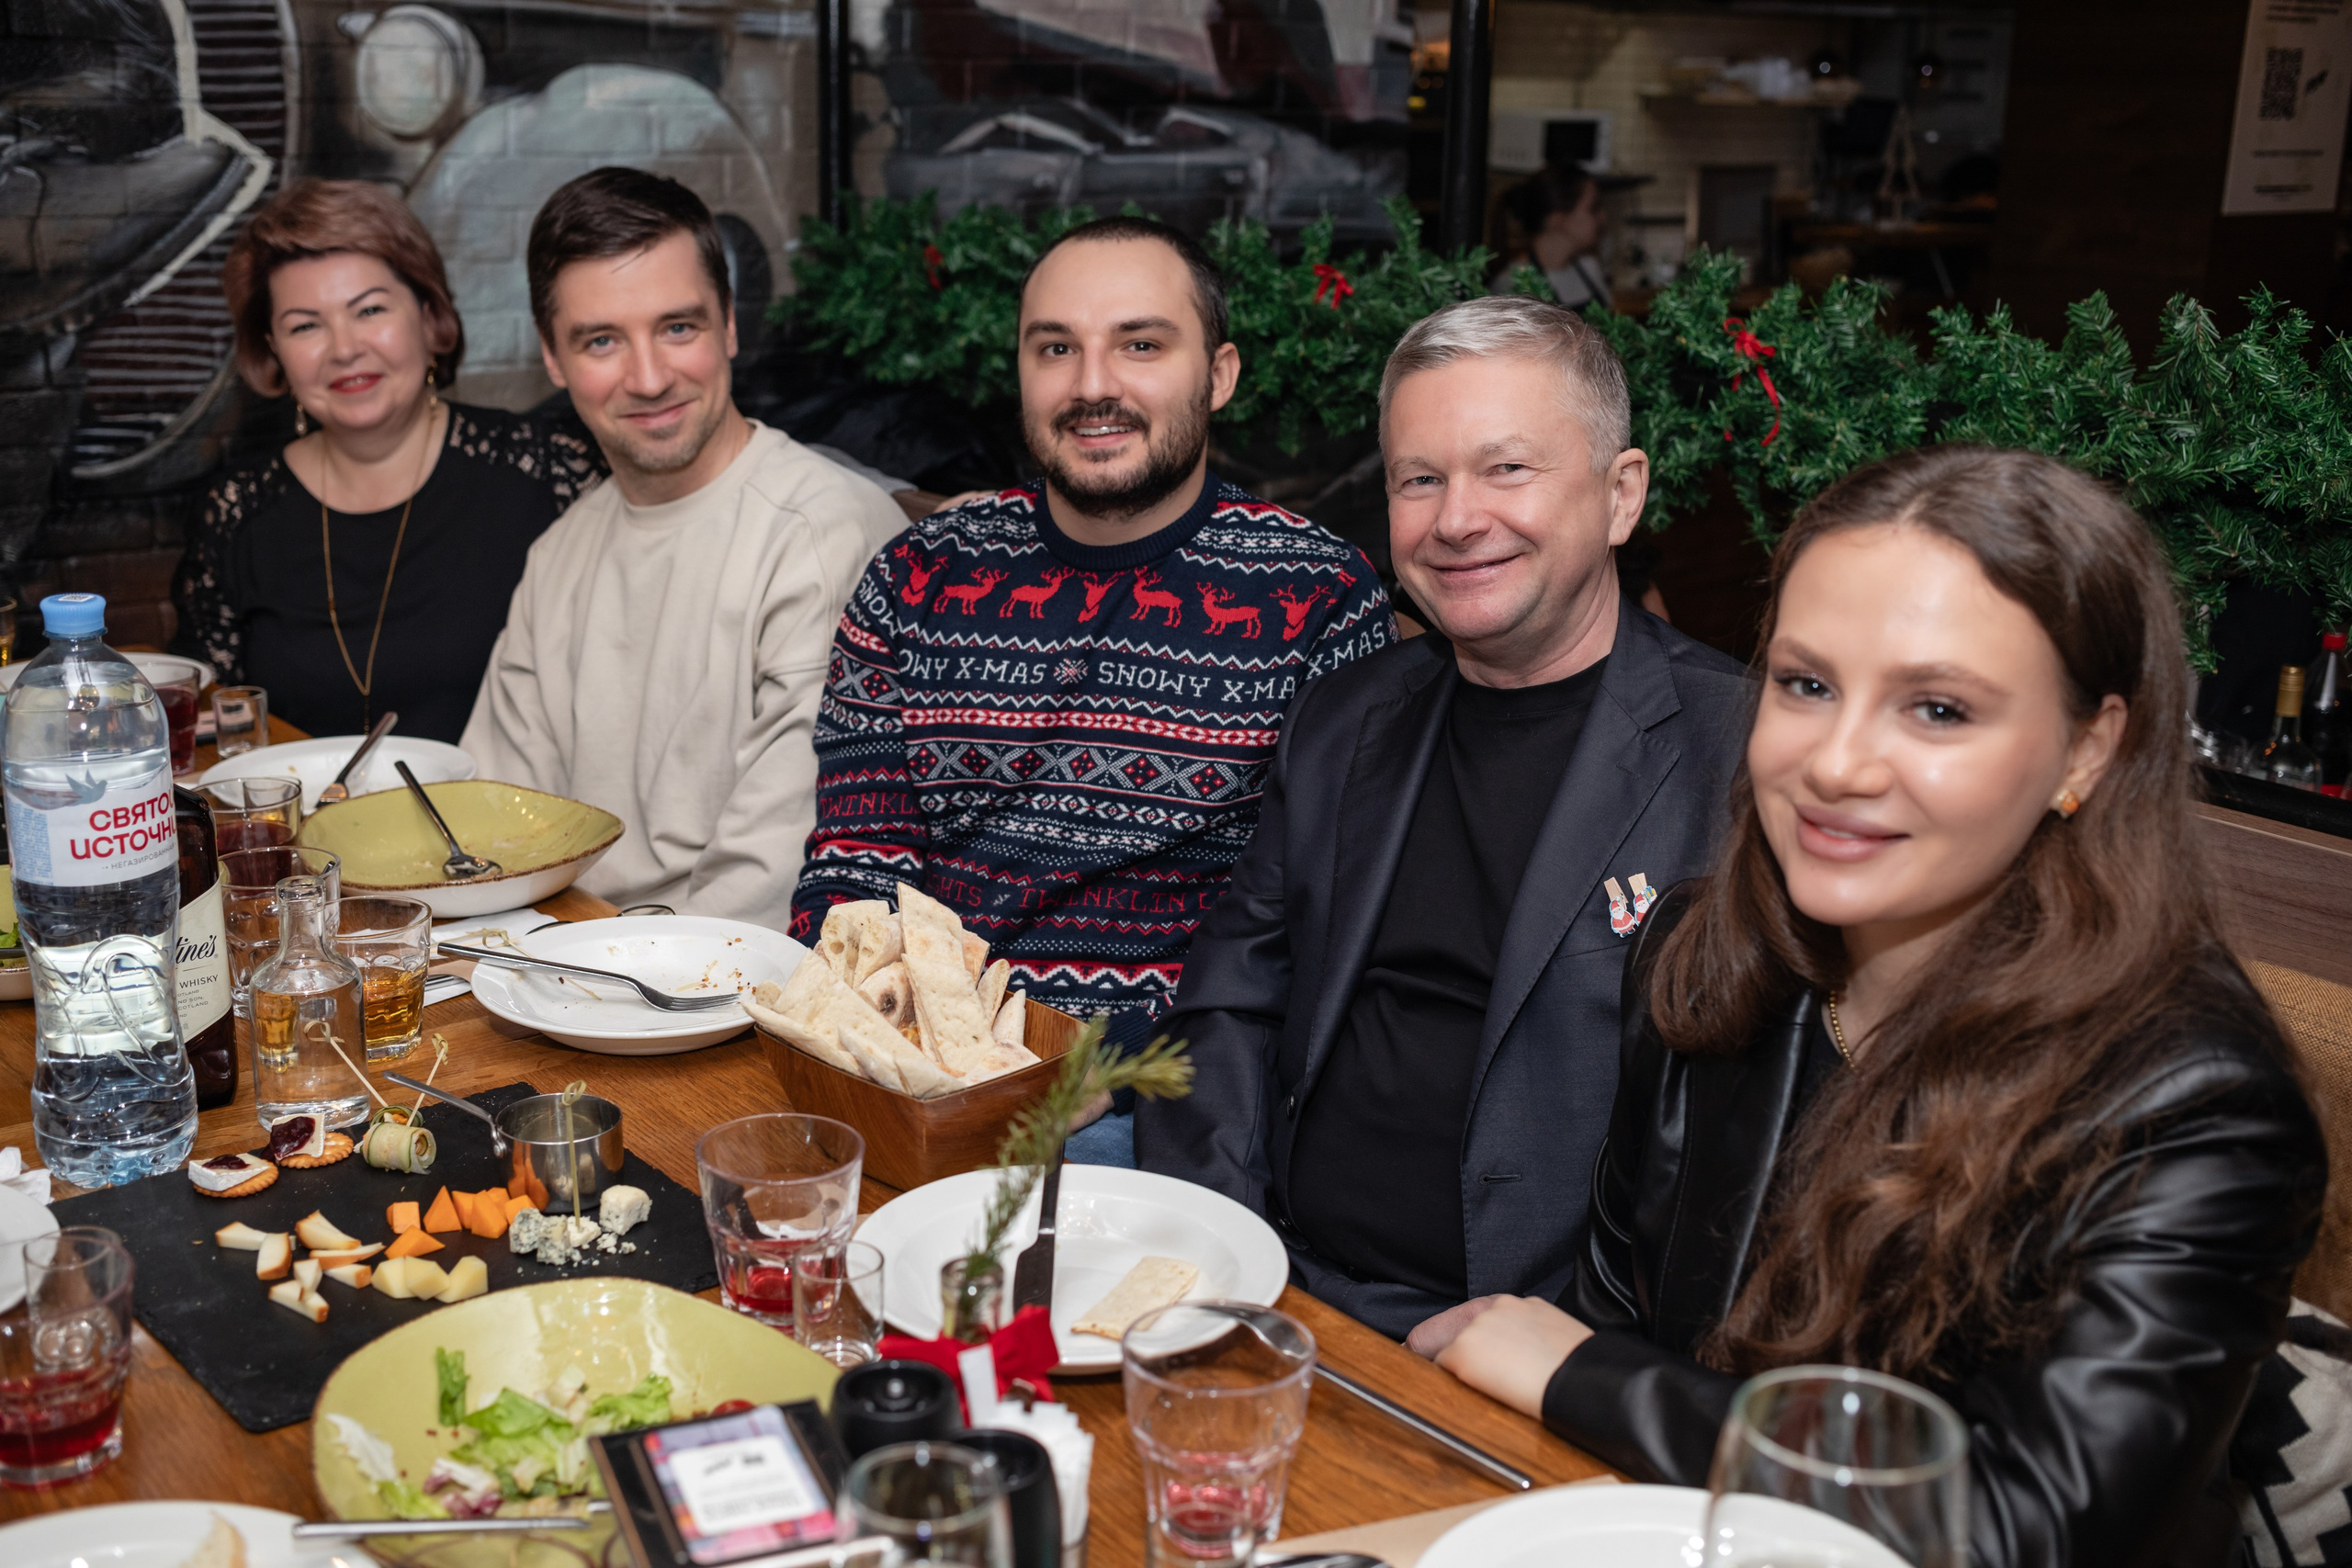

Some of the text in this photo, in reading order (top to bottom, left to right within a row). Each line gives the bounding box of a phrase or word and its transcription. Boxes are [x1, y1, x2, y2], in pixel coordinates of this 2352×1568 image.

[1306, 621, 1385, 681] X-MAS
[955, 657, 1047, 684] X-MAS
[1098, 661, 1211, 698] SNOWY
[820, 791, 921, 819] TWINKL
[179, 974, 219, 989] WHISKY
